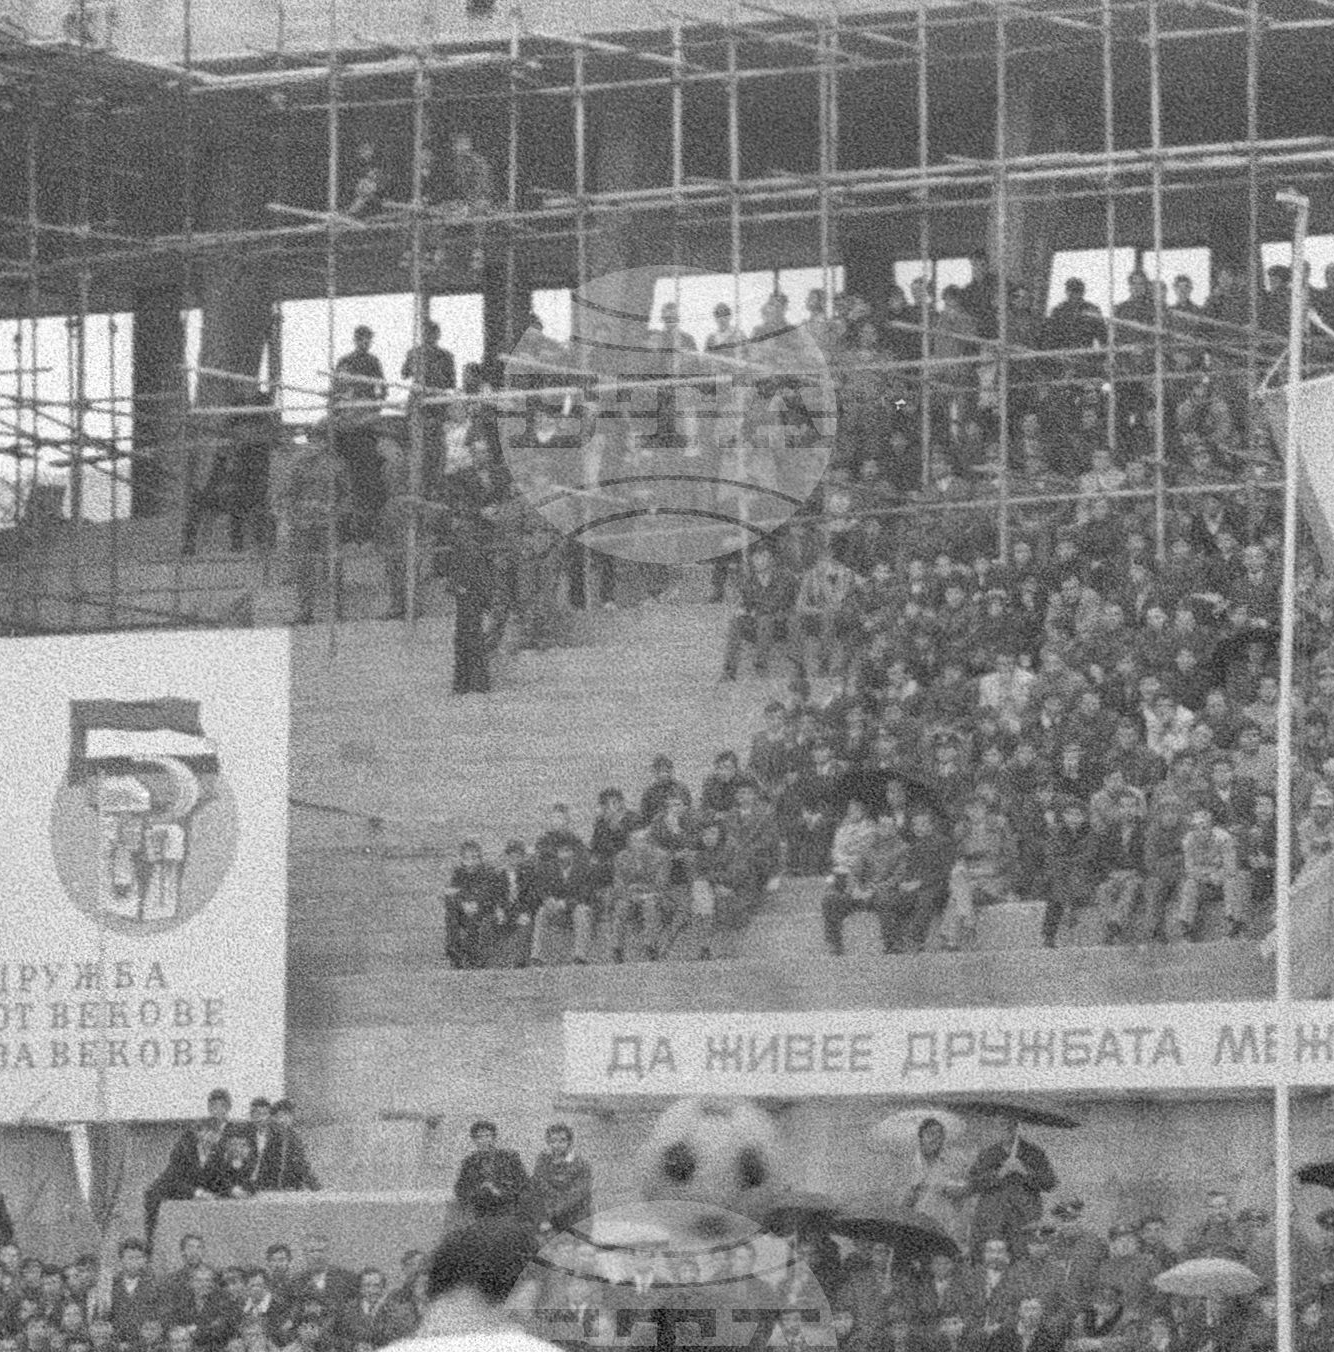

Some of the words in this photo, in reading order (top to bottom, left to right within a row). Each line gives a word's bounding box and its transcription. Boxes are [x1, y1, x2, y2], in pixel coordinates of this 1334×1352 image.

[48, 997, 226, 1029] ВЕКОВЕ
[48, 1036, 226, 1069] ВЕКОВЕ
[606, 1033, 676, 1079] ДА
[705, 1031, 873, 1074] ЖИВЕЕ
[900, 1024, 1185, 1078] ДРУЖБАТА
